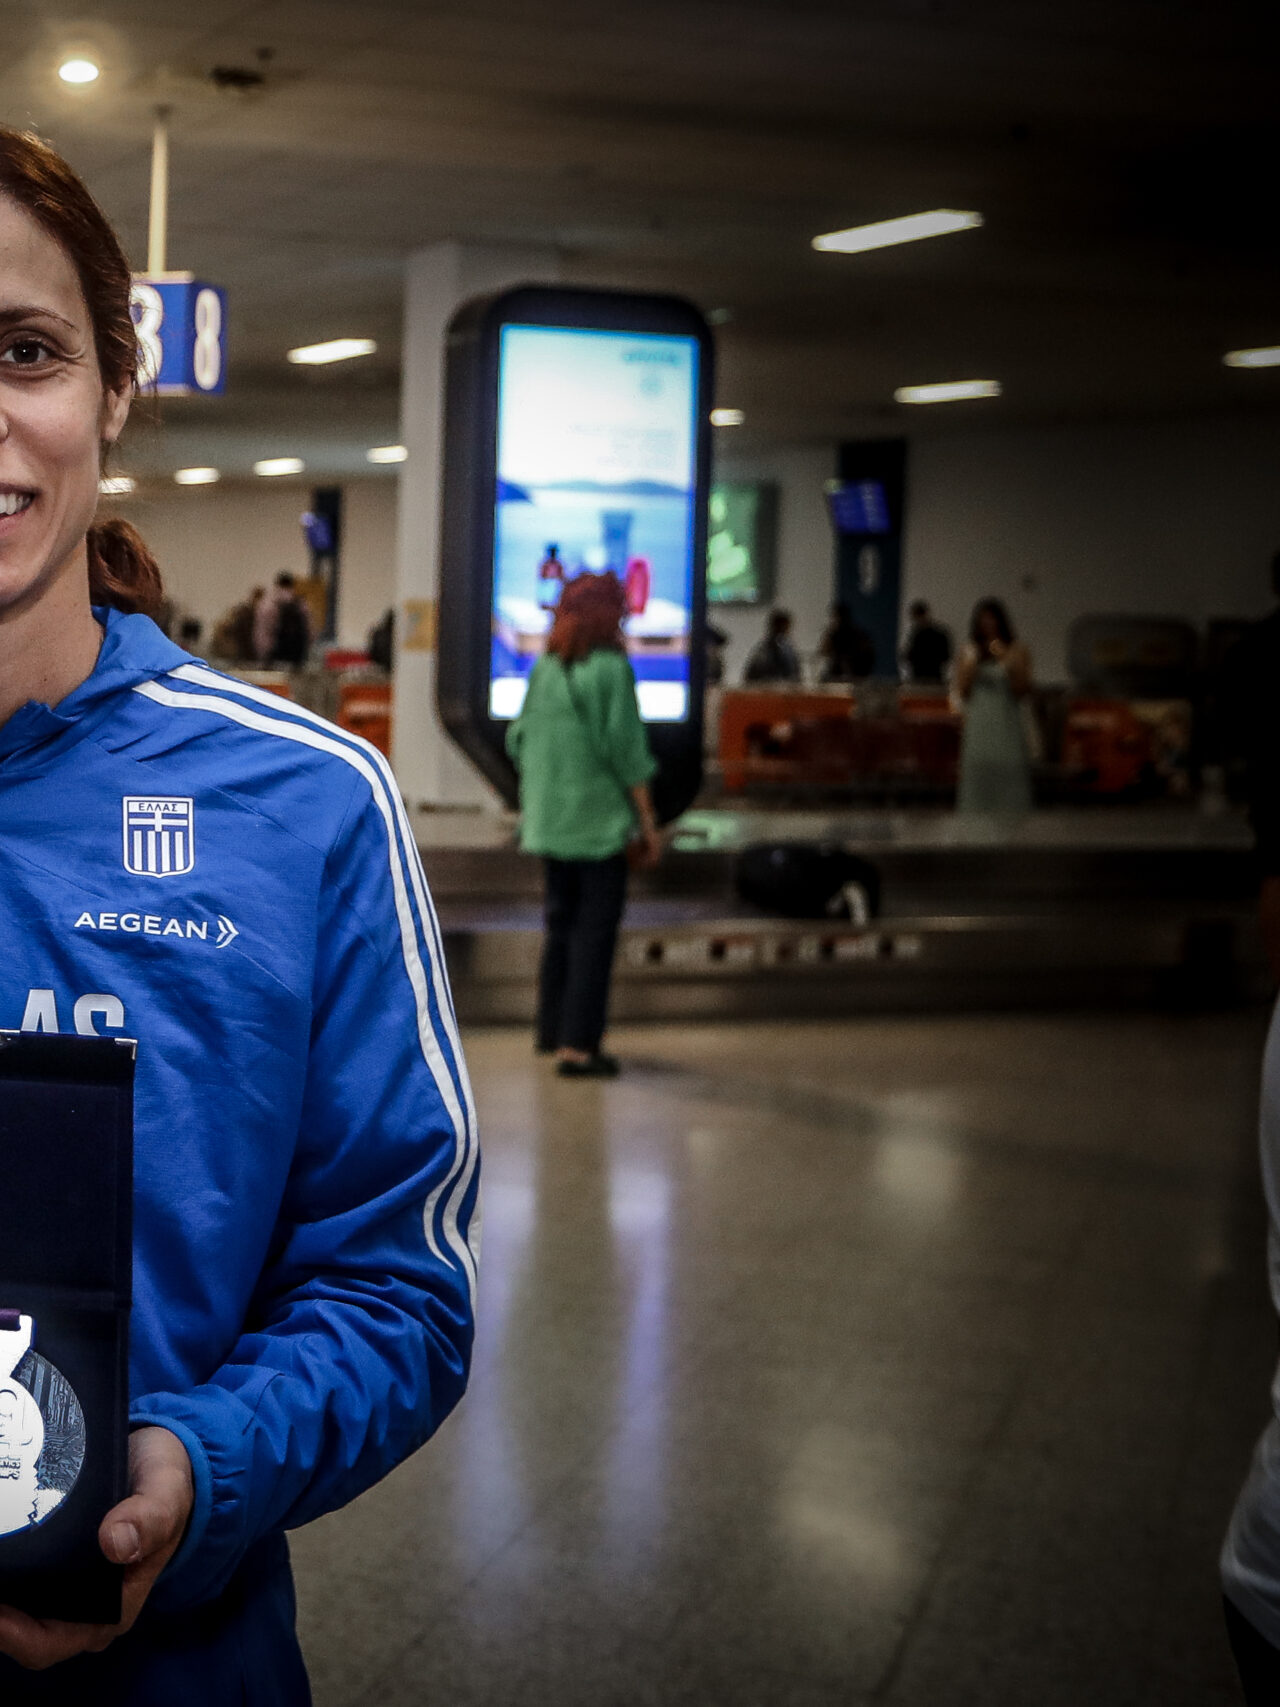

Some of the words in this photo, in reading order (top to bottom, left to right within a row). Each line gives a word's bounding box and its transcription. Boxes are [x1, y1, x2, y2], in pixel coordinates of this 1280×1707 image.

[194, 288, 221, 391] 8
[138, 802, 179, 813] ΕΛΛΑΣ
[74, 911, 209, 941] AEGEAN
